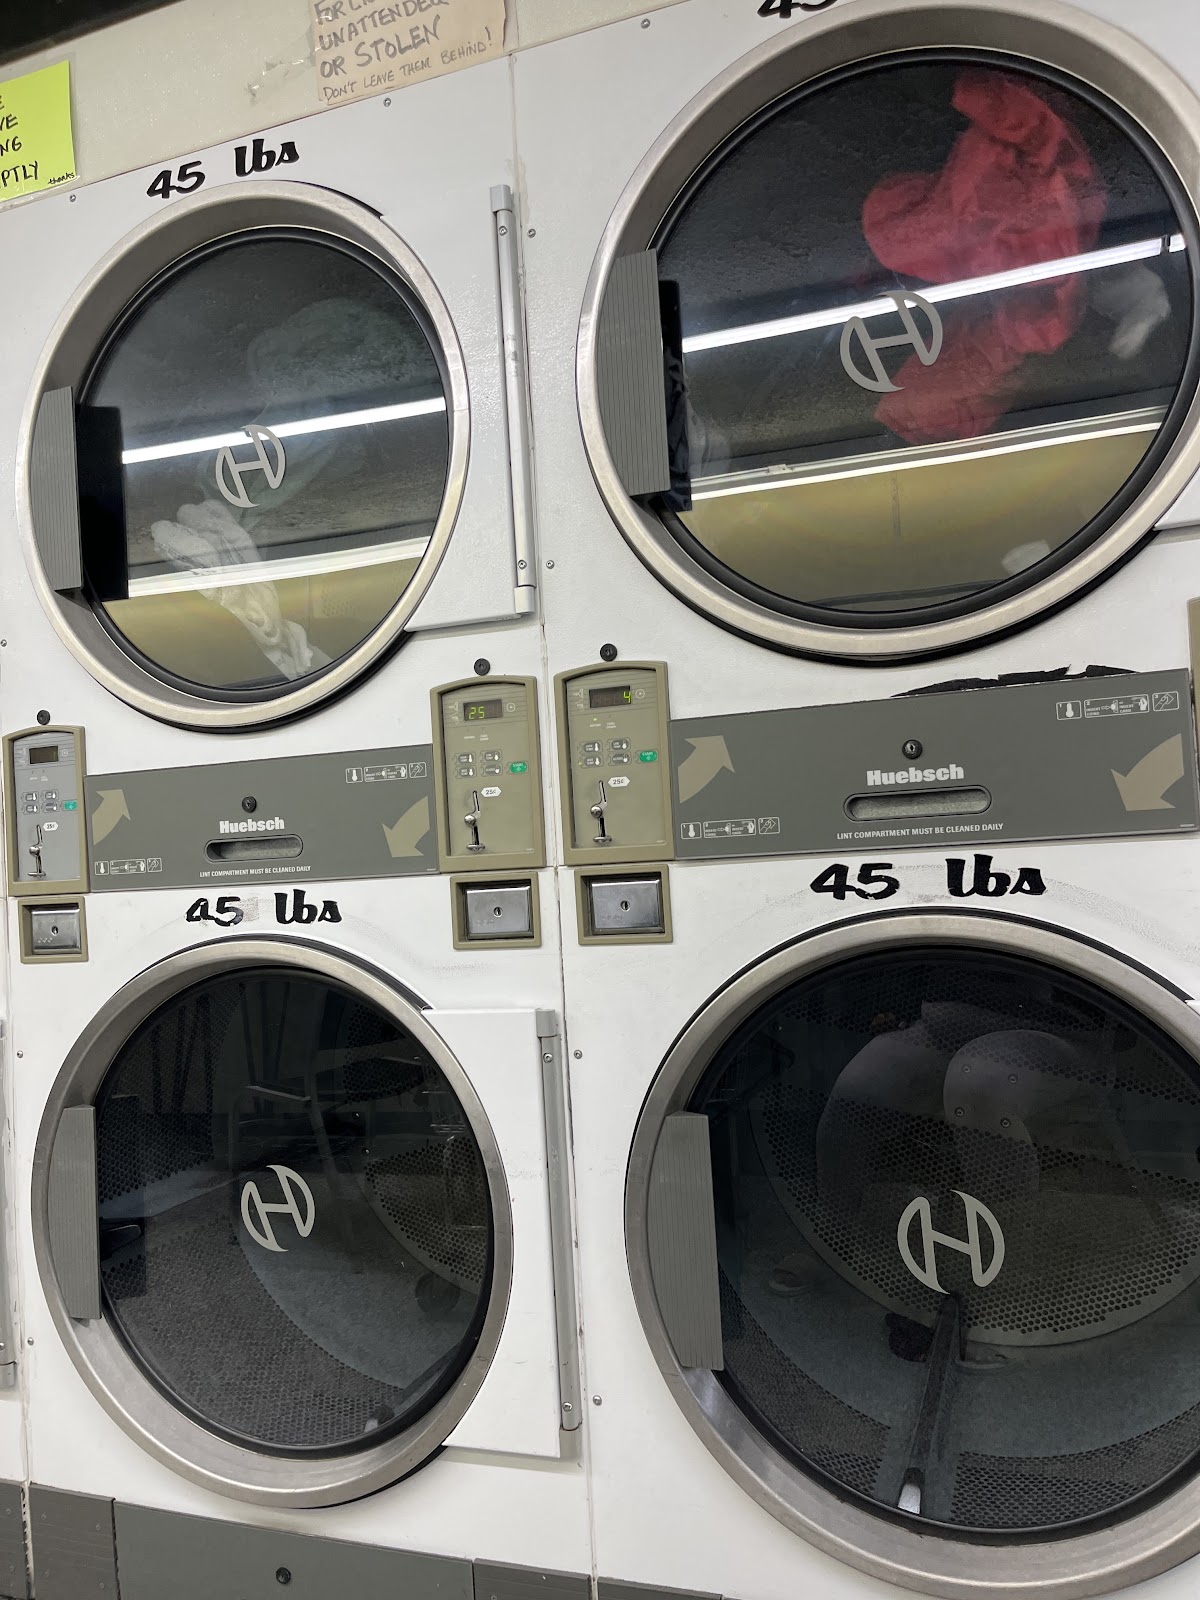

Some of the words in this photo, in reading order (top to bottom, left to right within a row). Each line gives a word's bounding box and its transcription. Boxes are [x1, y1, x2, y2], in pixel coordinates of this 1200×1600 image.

[320, 56, 347, 78] OR
[355, 14, 441, 67] STOLEN
[323, 81, 357, 100] DON'T
[364, 70, 395, 88] LEAVE
[400, 57, 431, 77] THEM
[146, 160, 206, 198] 45
[234, 138, 300, 177] lbs
[623, 690, 631, 704] 4
[468, 706, 485, 720] 25
[866, 763, 965, 786] Huebsch
[219, 816, 285, 834] Huebsch
[836, 832, 853, 840] LINT
[853, 829, 911, 839] COMPARTMENT
[934, 826, 945, 834] BE
[945, 824, 981, 834] CLEANED
[981, 823, 1004, 831] DAILY
[211, 869, 249, 877] COMPARTMENT
[272, 866, 296, 874] CLEANED
[810, 862, 900, 900] 45
[945, 854, 1047, 898] lbs
[274, 888, 343, 924] lbs
